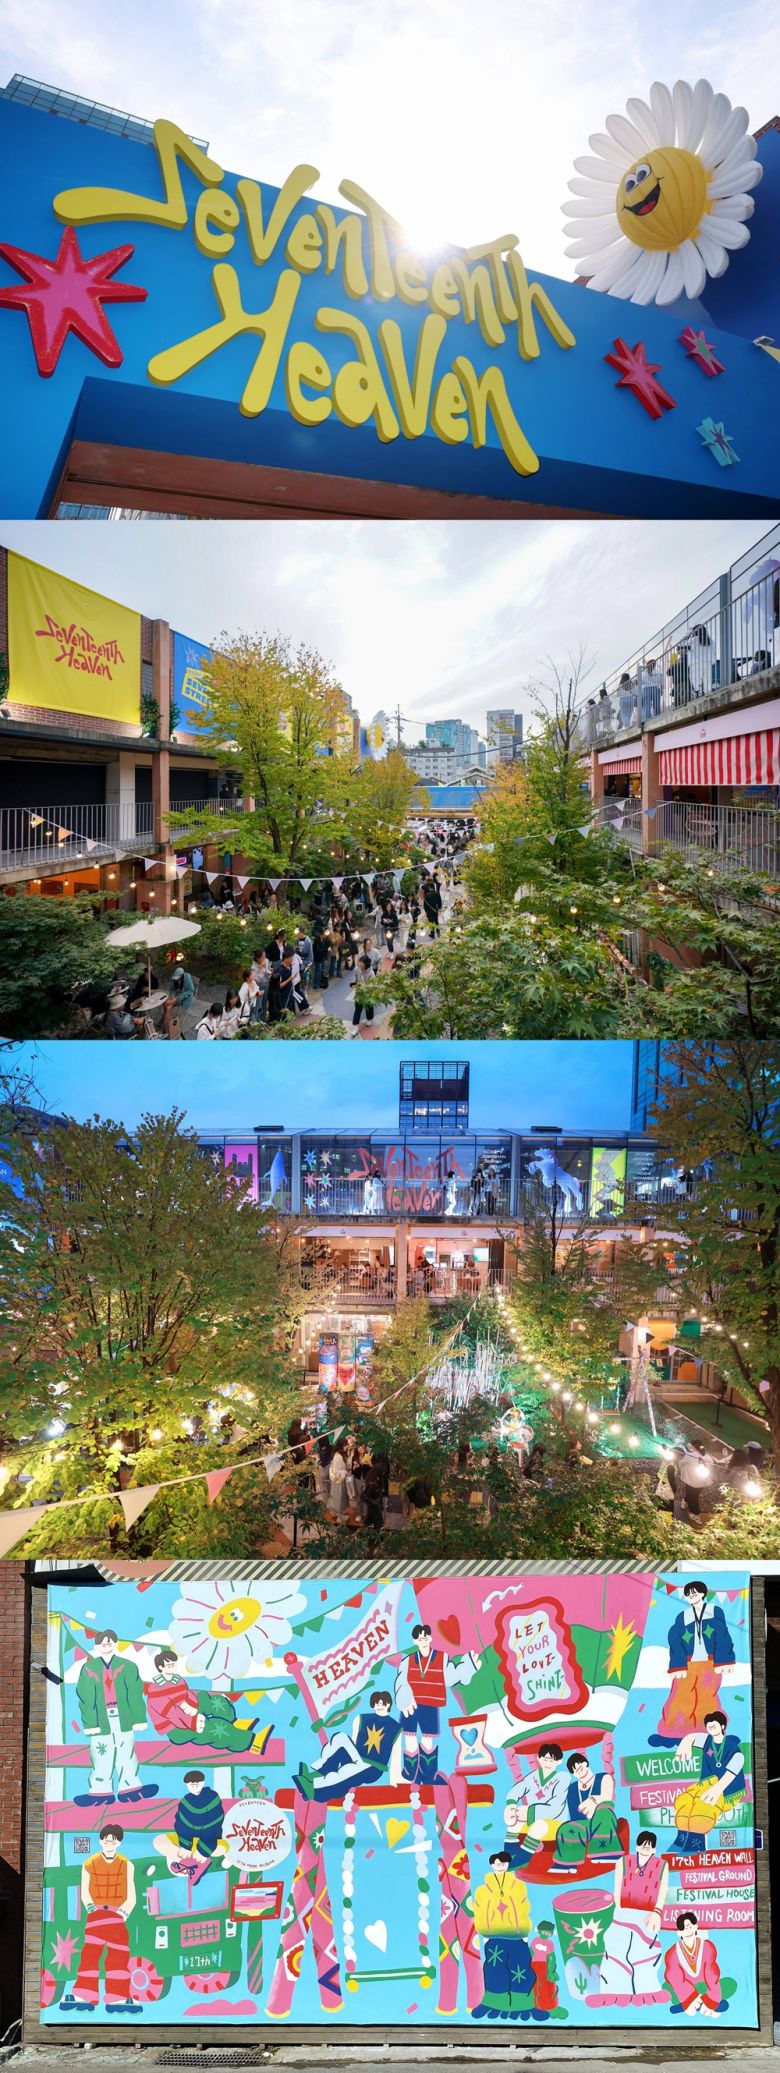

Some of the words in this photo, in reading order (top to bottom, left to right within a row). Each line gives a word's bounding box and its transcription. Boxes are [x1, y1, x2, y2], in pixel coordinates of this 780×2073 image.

[516, 1622, 543, 1638] LET
[312, 1620, 390, 1688] HEAVEN
[519, 1635, 549, 1658] YOUR
[636, 1756, 701, 1776] WELCOME
[672, 1856, 695, 1867] 17th
[698, 1852, 731, 1866] HEAVEN
[733, 1851, 754, 1863] WALL
[685, 1871, 718, 1884] FESTIVAL
[718, 1869, 752, 1882] GROUND
[676, 1889, 724, 1902] FESTIVAL
[726, 1888, 755, 1900] HOUSE
[727, 1909, 755, 1922] ROOM
